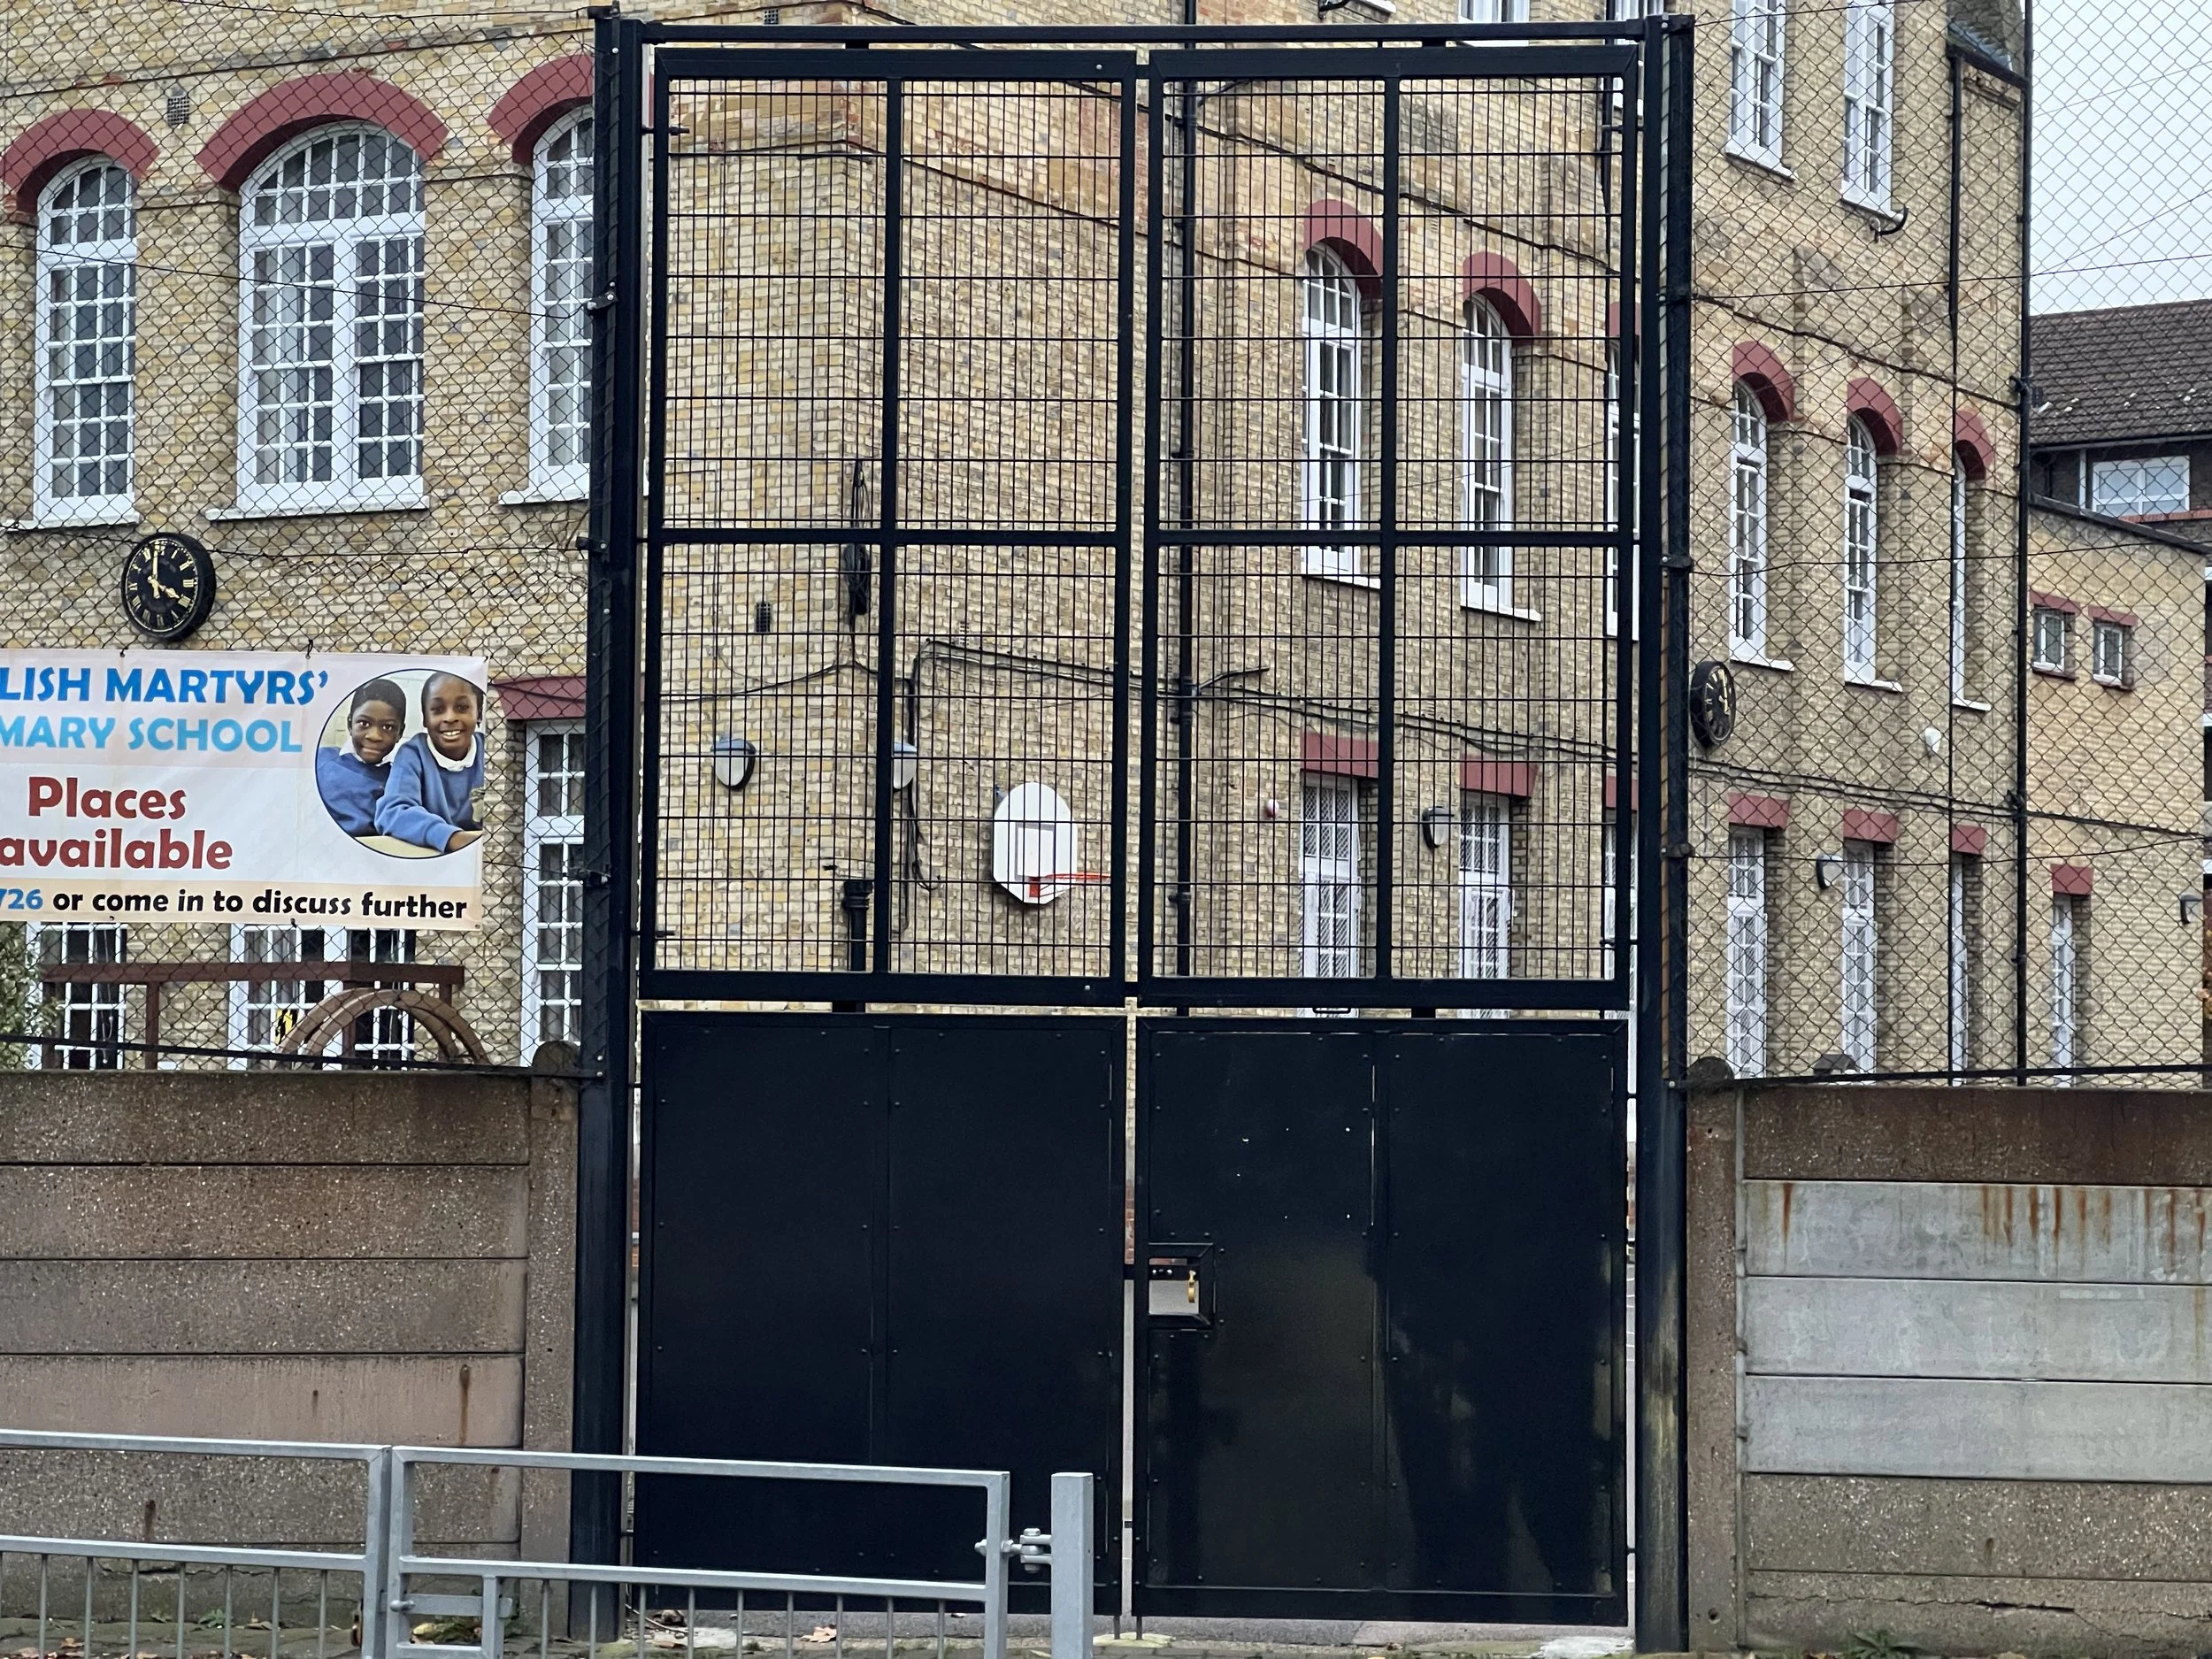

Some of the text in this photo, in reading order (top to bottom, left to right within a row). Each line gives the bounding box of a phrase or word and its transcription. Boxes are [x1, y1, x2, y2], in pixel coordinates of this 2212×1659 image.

[0, 666, 328, 705] LISH MARTYRS’
[0, 715, 303, 753] MARY SCHOOL
[29, 777, 185, 819] Places
[0, 828, 233, 870] available
[53, 893, 84, 910] or
[92, 894, 168, 912] come
[179, 888, 204, 912] in
[213, 890, 243, 913] to
[252, 889, 351, 915] discuss
[361, 892, 467, 918] further
